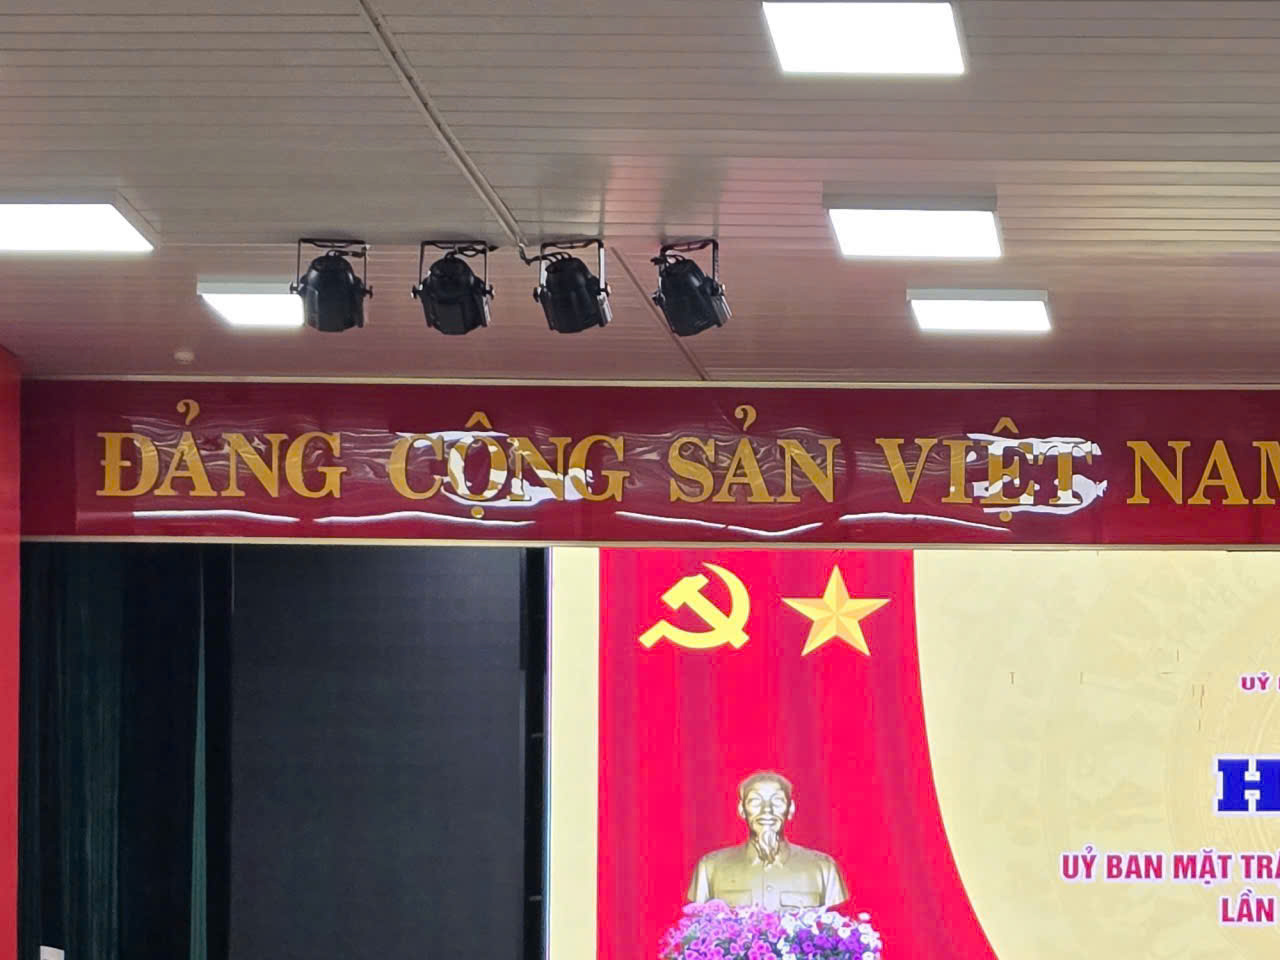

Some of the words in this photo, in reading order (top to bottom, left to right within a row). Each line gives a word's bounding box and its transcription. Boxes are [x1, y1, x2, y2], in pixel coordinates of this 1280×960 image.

[96, 399, 344, 498] ĐẢNG
[388, 411, 631, 519] CỘNG
[668, 404, 838, 504] SẢN
[875, 416, 1094, 523] VIỆT
[1062, 846, 1097, 879] UỶ
[1106, 854, 1163, 879] BAN
[1173, 849, 1232, 885] MẶT
[1221, 889, 1274, 923] LẦN
